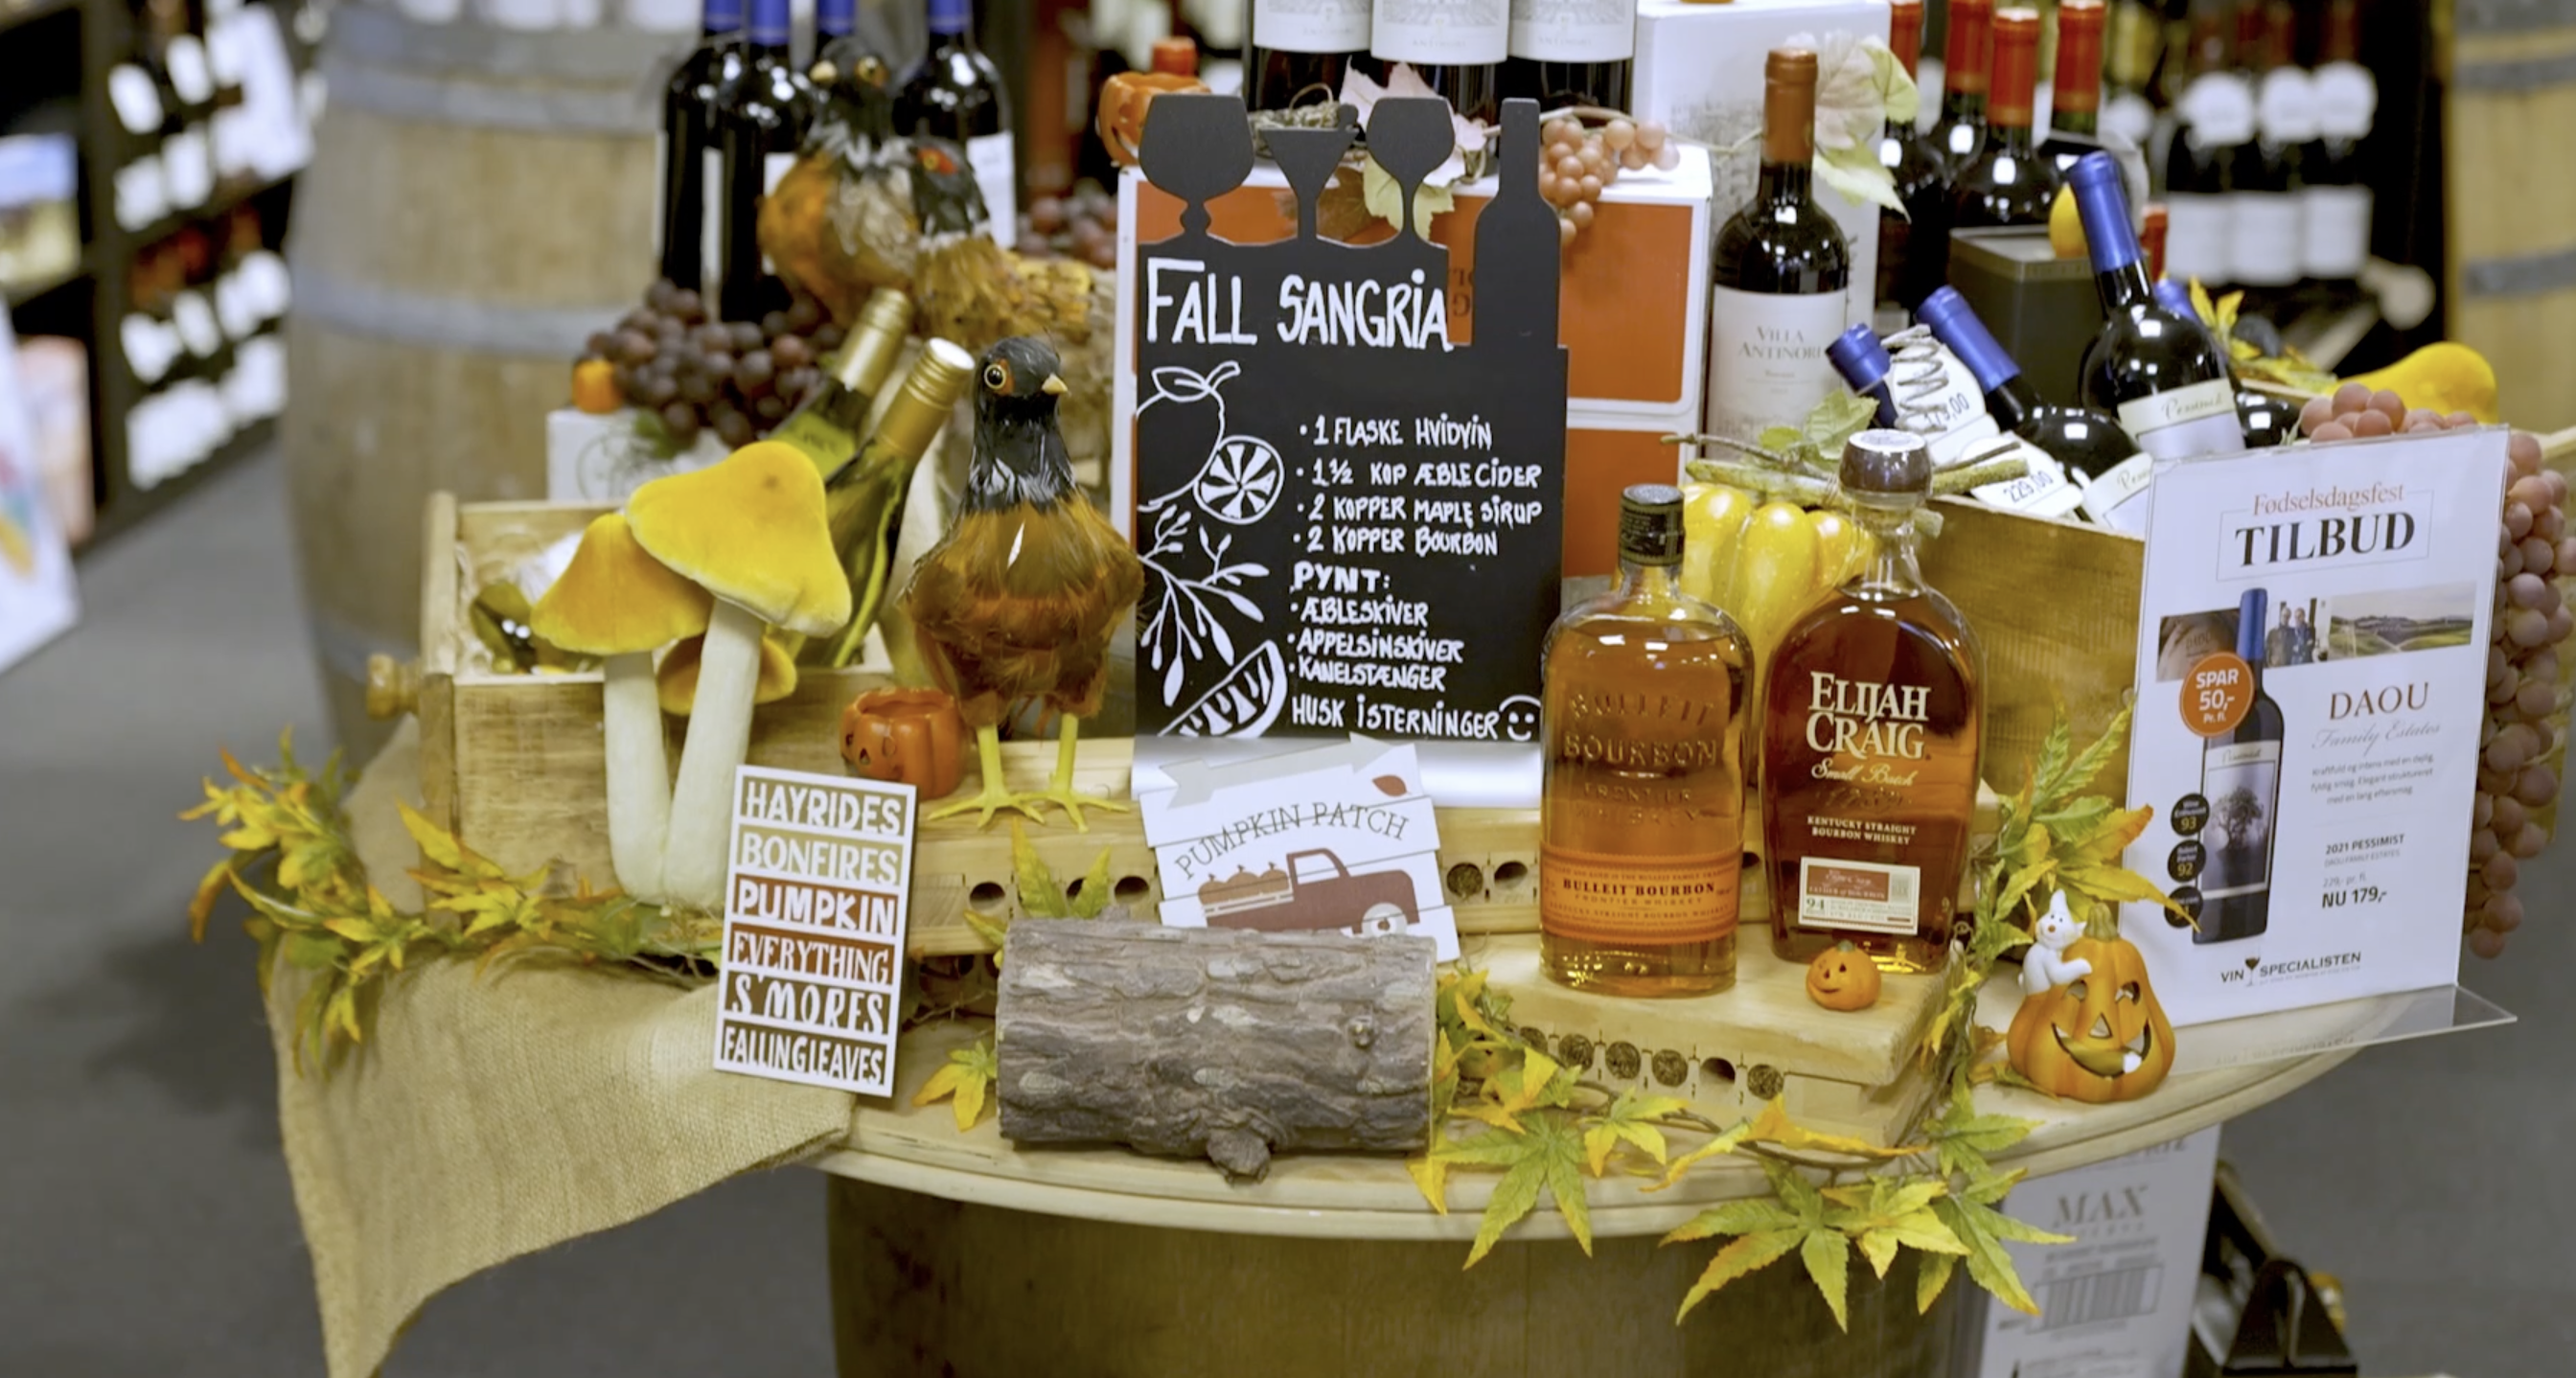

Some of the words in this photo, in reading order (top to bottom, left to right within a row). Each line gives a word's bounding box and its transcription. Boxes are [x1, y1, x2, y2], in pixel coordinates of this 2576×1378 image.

[1147, 257, 1258, 345] FALL
[1737, 340, 1822, 360] ANTINORI
[1757, 325, 1805, 343] VILLA
[1313, 415, 1329, 447] 1
[1334, 417, 1404, 448] FLASKE
[1370, 462, 1407, 486] KOP
[2003, 470, 2055, 503] 229,00
[1308, 493, 1324, 521] 2
[1333, 495, 1407, 521] KOPPER
[1414, 498, 1474, 529] MAPLE
[2253, 481, 2405, 517] Fødselsdagsfest
[1307, 525, 1323, 553] 2
[1332, 525, 1406, 555] KOPPER
[1414, 525, 1498, 557] BOURBON
[2235, 511, 2416, 567] TILBUD
[1292, 561, 1391, 593] PYNT:
[1300, 594, 1429, 628] ÆBLESKIVER
[1297, 629, 1464, 663] APPELSINSKIVER
[1298, 657, 1447, 692] KANELSTÆNGER
[2196, 668, 2240, 690] SPAR
[1292, 696, 1346, 727] HUSK
[1807, 671, 1932, 723] ELIJAH
[2198, 688, 2236, 712] 50,-
[2329, 681, 2429, 721] DAOU
[1563, 728, 1717, 767] BOURBON
[1806, 711, 1924, 760] CRAIG
[2312, 723, 2380, 758] Family
[2384, 718, 2441, 742] Estates
[1811, 756, 1864, 782] Small
[1860, 762, 1919, 787] Batch
[746, 781, 902, 837] HAYRIDES
[1807, 815, 1863, 831] KENTUCKY
[1864, 821, 1917, 836] STRAIGHT
[2181, 815, 2196, 831] 93
[1174, 803, 1301, 881] PUMPKIN
[1311, 801, 1410, 841] PATCH
[1811, 825, 1862, 840] BOURBON
[1863, 831, 1911, 846] WHISKEY
[2326, 840, 2349, 856] 2021
[2352, 832, 2404, 852] PESSIMIST
[742, 831, 898, 886] BONFIRES
[2177, 861, 2193, 877] 92
[1563, 877, 1627, 896] BULLEIT
[1635, 882, 1715, 898] BOURBON
[2322, 889, 2347, 908] NU
[2352, 885, 2387, 904] 179,-
[737, 879, 895, 935] PUMPKIN
[731, 930, 889, 986] EVERYTHING
[2220, 968, 2244, 983] VIN
[2259, 951, 2362, 978] SPECIALISTEN
[731, 972, 885, 1038] S'MORES
[2053, 1182, 2150, 1229] MAX
